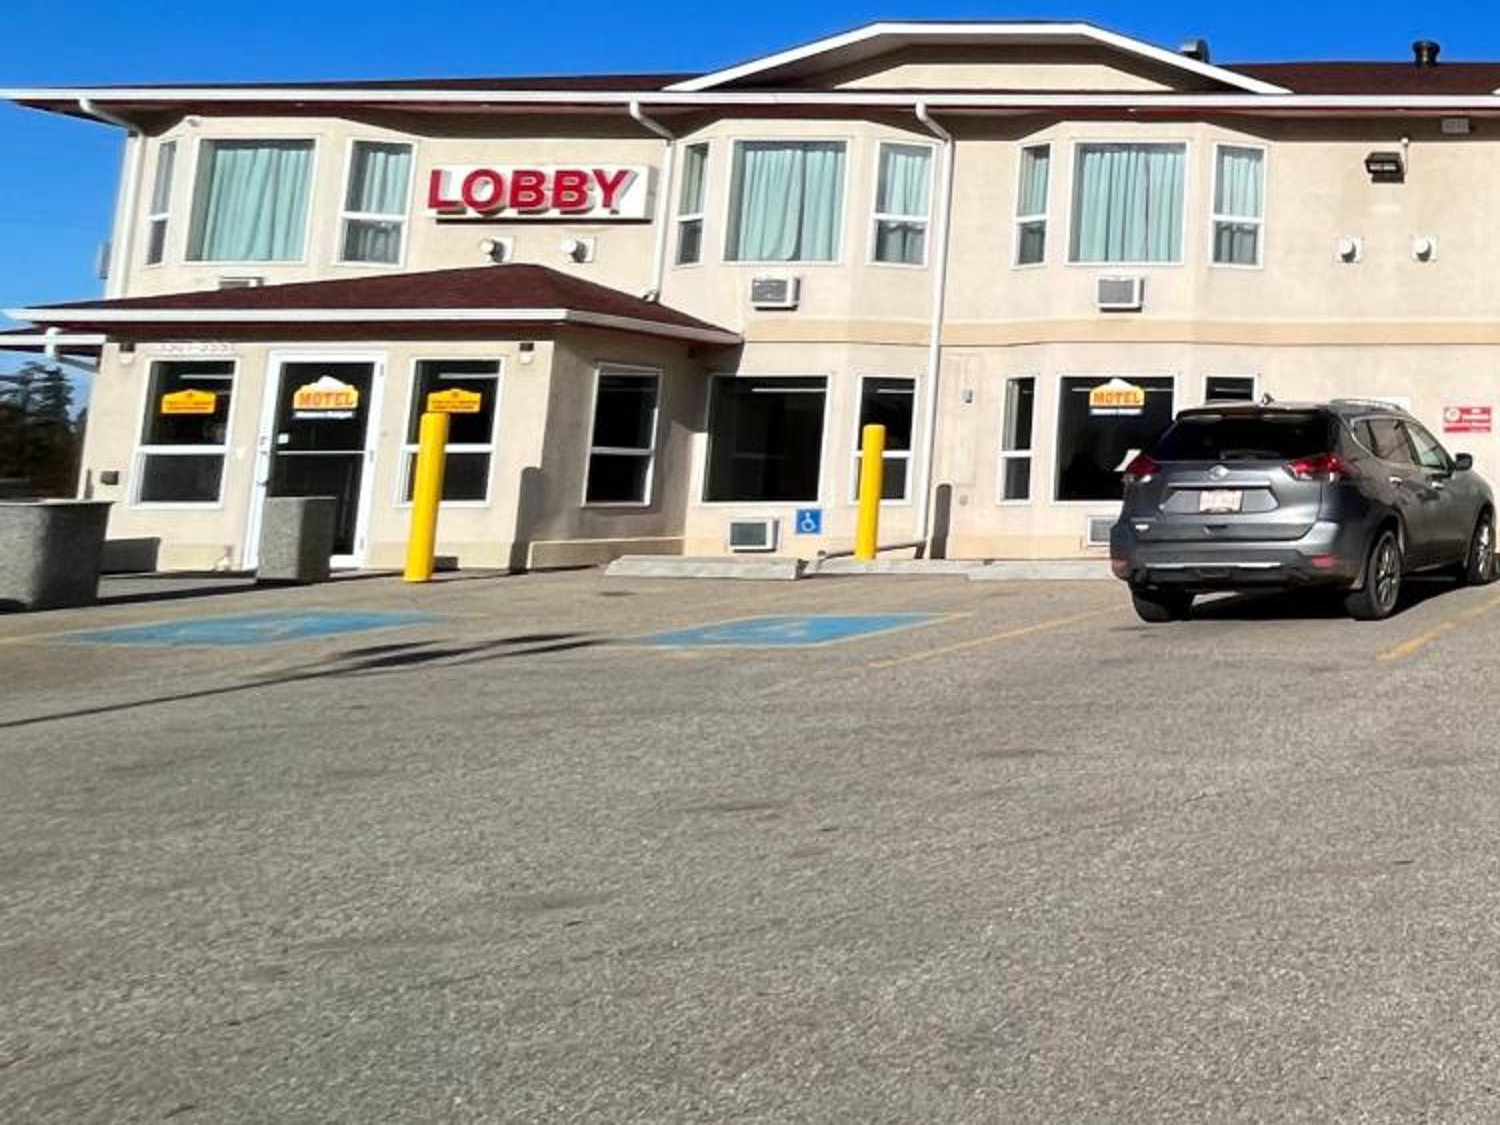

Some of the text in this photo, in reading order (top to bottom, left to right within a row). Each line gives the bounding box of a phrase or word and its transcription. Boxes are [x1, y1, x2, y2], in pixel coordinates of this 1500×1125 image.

[428, 168, 632, 211] LOBBY
[298, 391, 354, 406] MOTEL
[1092, 391, 1141, 404] MOTEL
